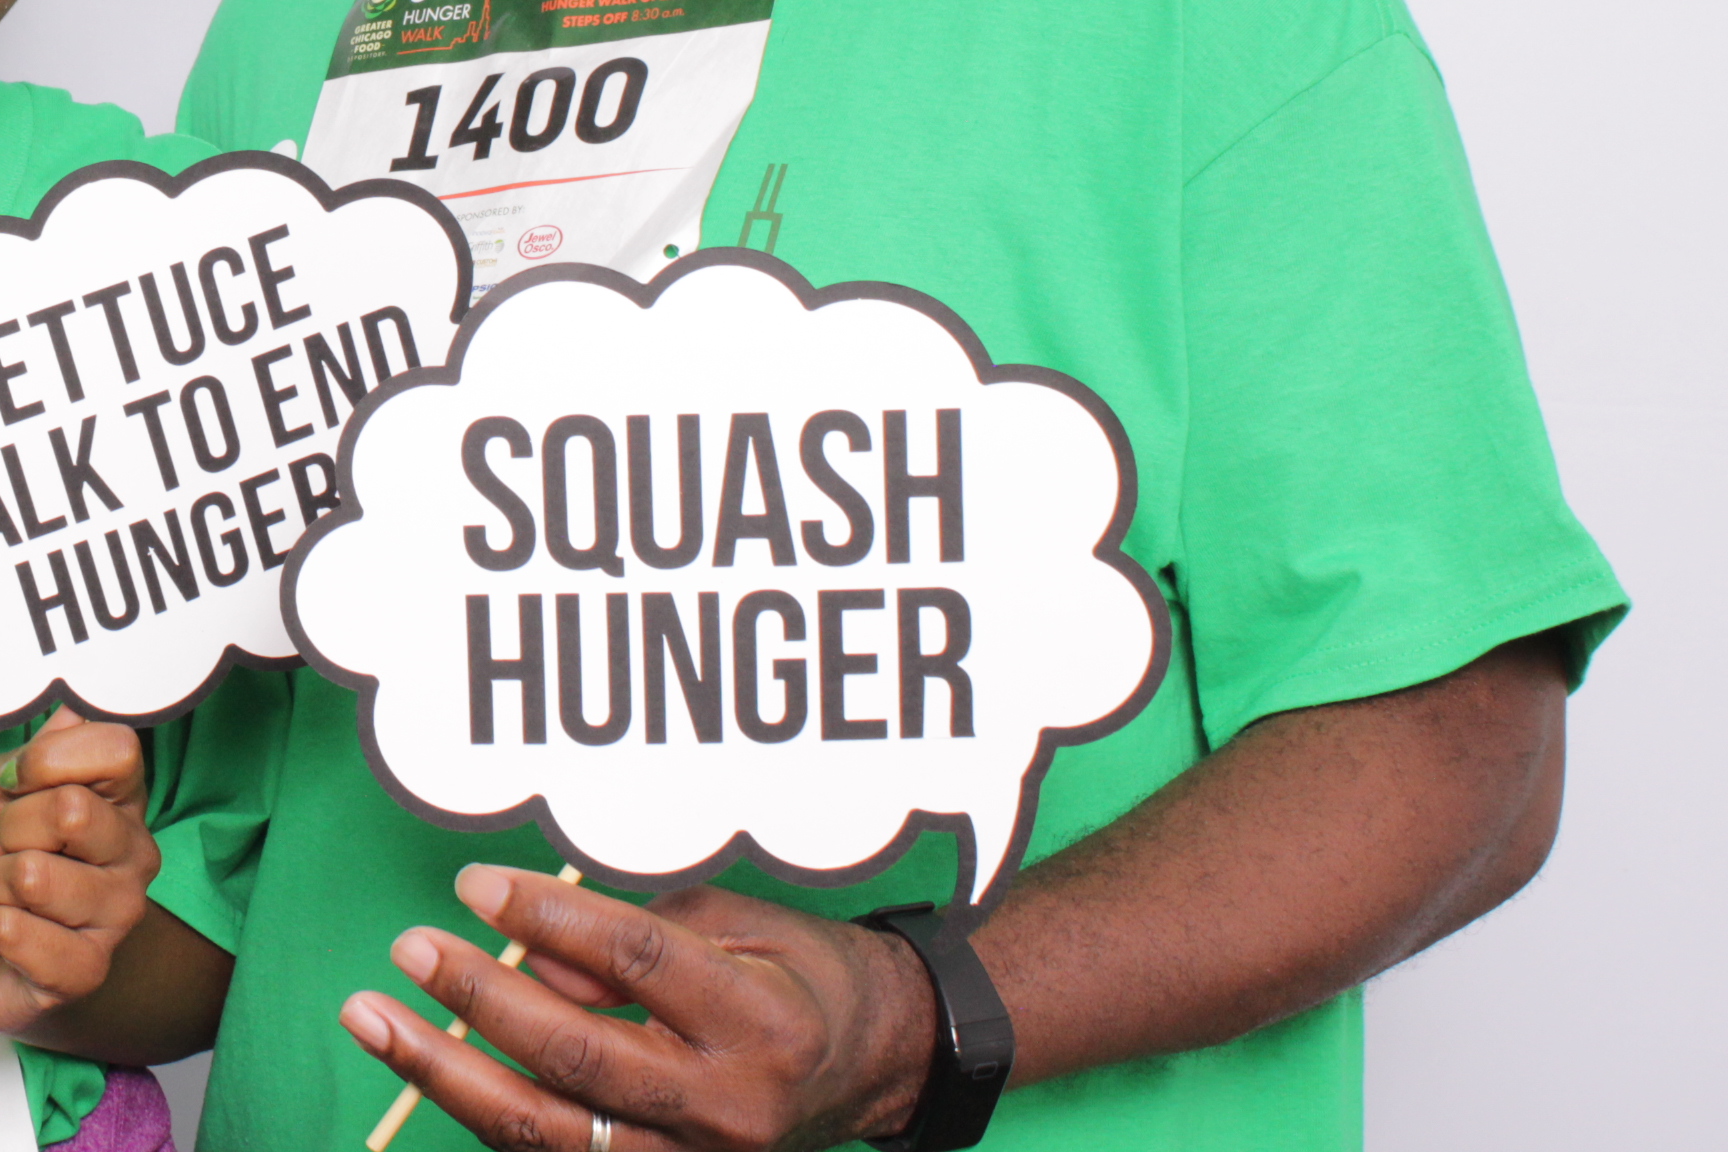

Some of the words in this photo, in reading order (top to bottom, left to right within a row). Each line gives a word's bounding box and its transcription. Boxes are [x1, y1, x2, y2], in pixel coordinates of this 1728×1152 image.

[402, 3, 472, 26] HUNGER
[562, 13, 601, 28] STEPS
[603, 11, 629, 25] OFF
[630, 8, 660, 22] 8:30
[354, 19, 393, 35] GREATER
[401, 25, 445, 44] WALK
[350, 30, 392, 46] CHICAGO
[353, 42, 381, 54] FOOD
[388, 56, 649, 173] 1400
[523, 231, 557, 244] Jewel
[122, 374, 241, 492] TO
[460, 408, 966, 578] SQUASH
[14, 452, 342, 657] HUNGER
[465, 586, 977, 747] HUNGER
